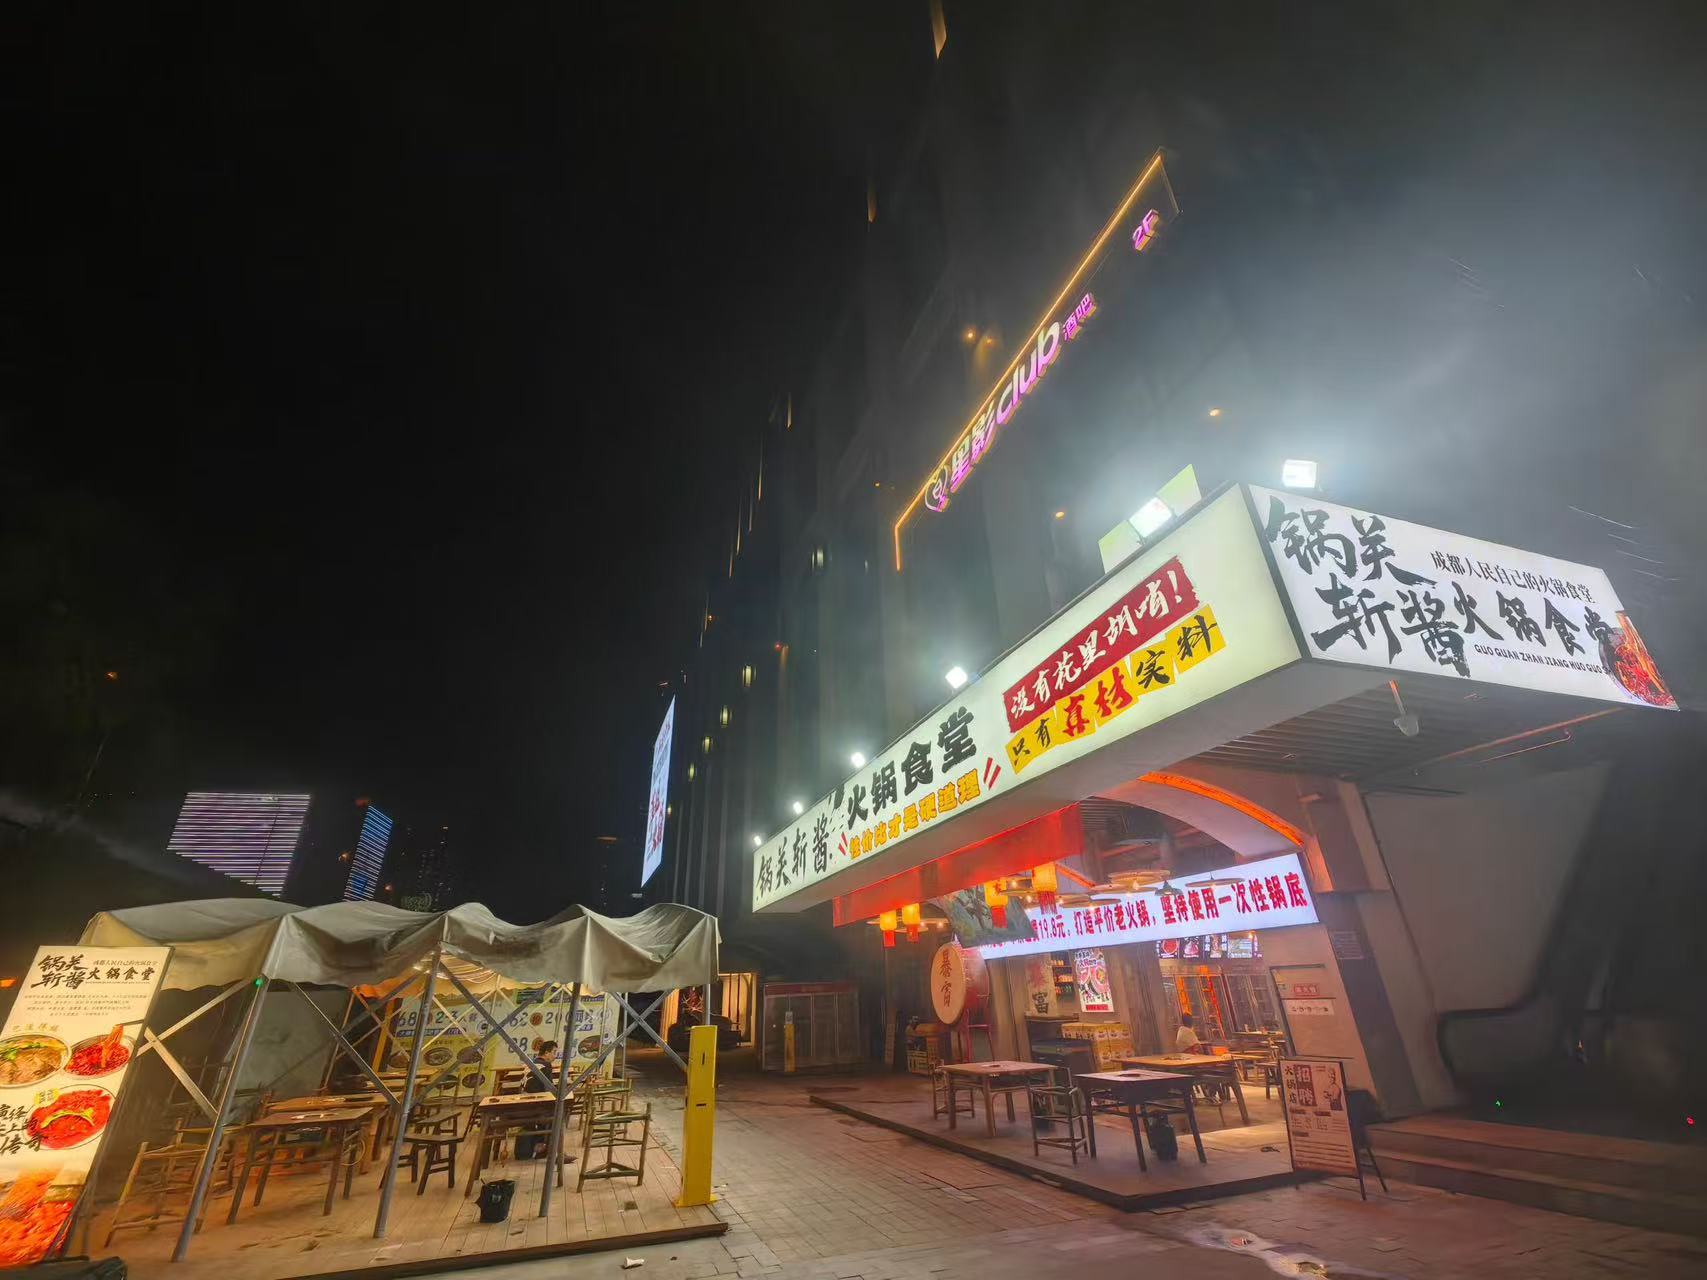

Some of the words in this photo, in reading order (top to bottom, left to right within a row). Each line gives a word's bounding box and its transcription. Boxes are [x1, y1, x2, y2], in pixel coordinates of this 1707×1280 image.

[997, 322, 1060, 424] club
[1063, 292, 1094, 340] 酒吧
[1133, 208, 1160, 250] 2F
[1431, 550, 1596, 604] 成都人民自己的火锅食堂
[1013, 614, 1217, 766] 只有真材实料
[1474, 643, 1494, 656] GUO
[1495, 647, 1520, 661] GUAN
[1520, 652, 1543, 663] ZHAN
[1545, 656, 1570, 669] JIANG
[1570, 660, 1587, 672] HUO
[1586, 663, 1602, 674] GUO
[848, 706, 977, 830] 火锅食堂
[87, 966, 155, 981] 火锅食堂
